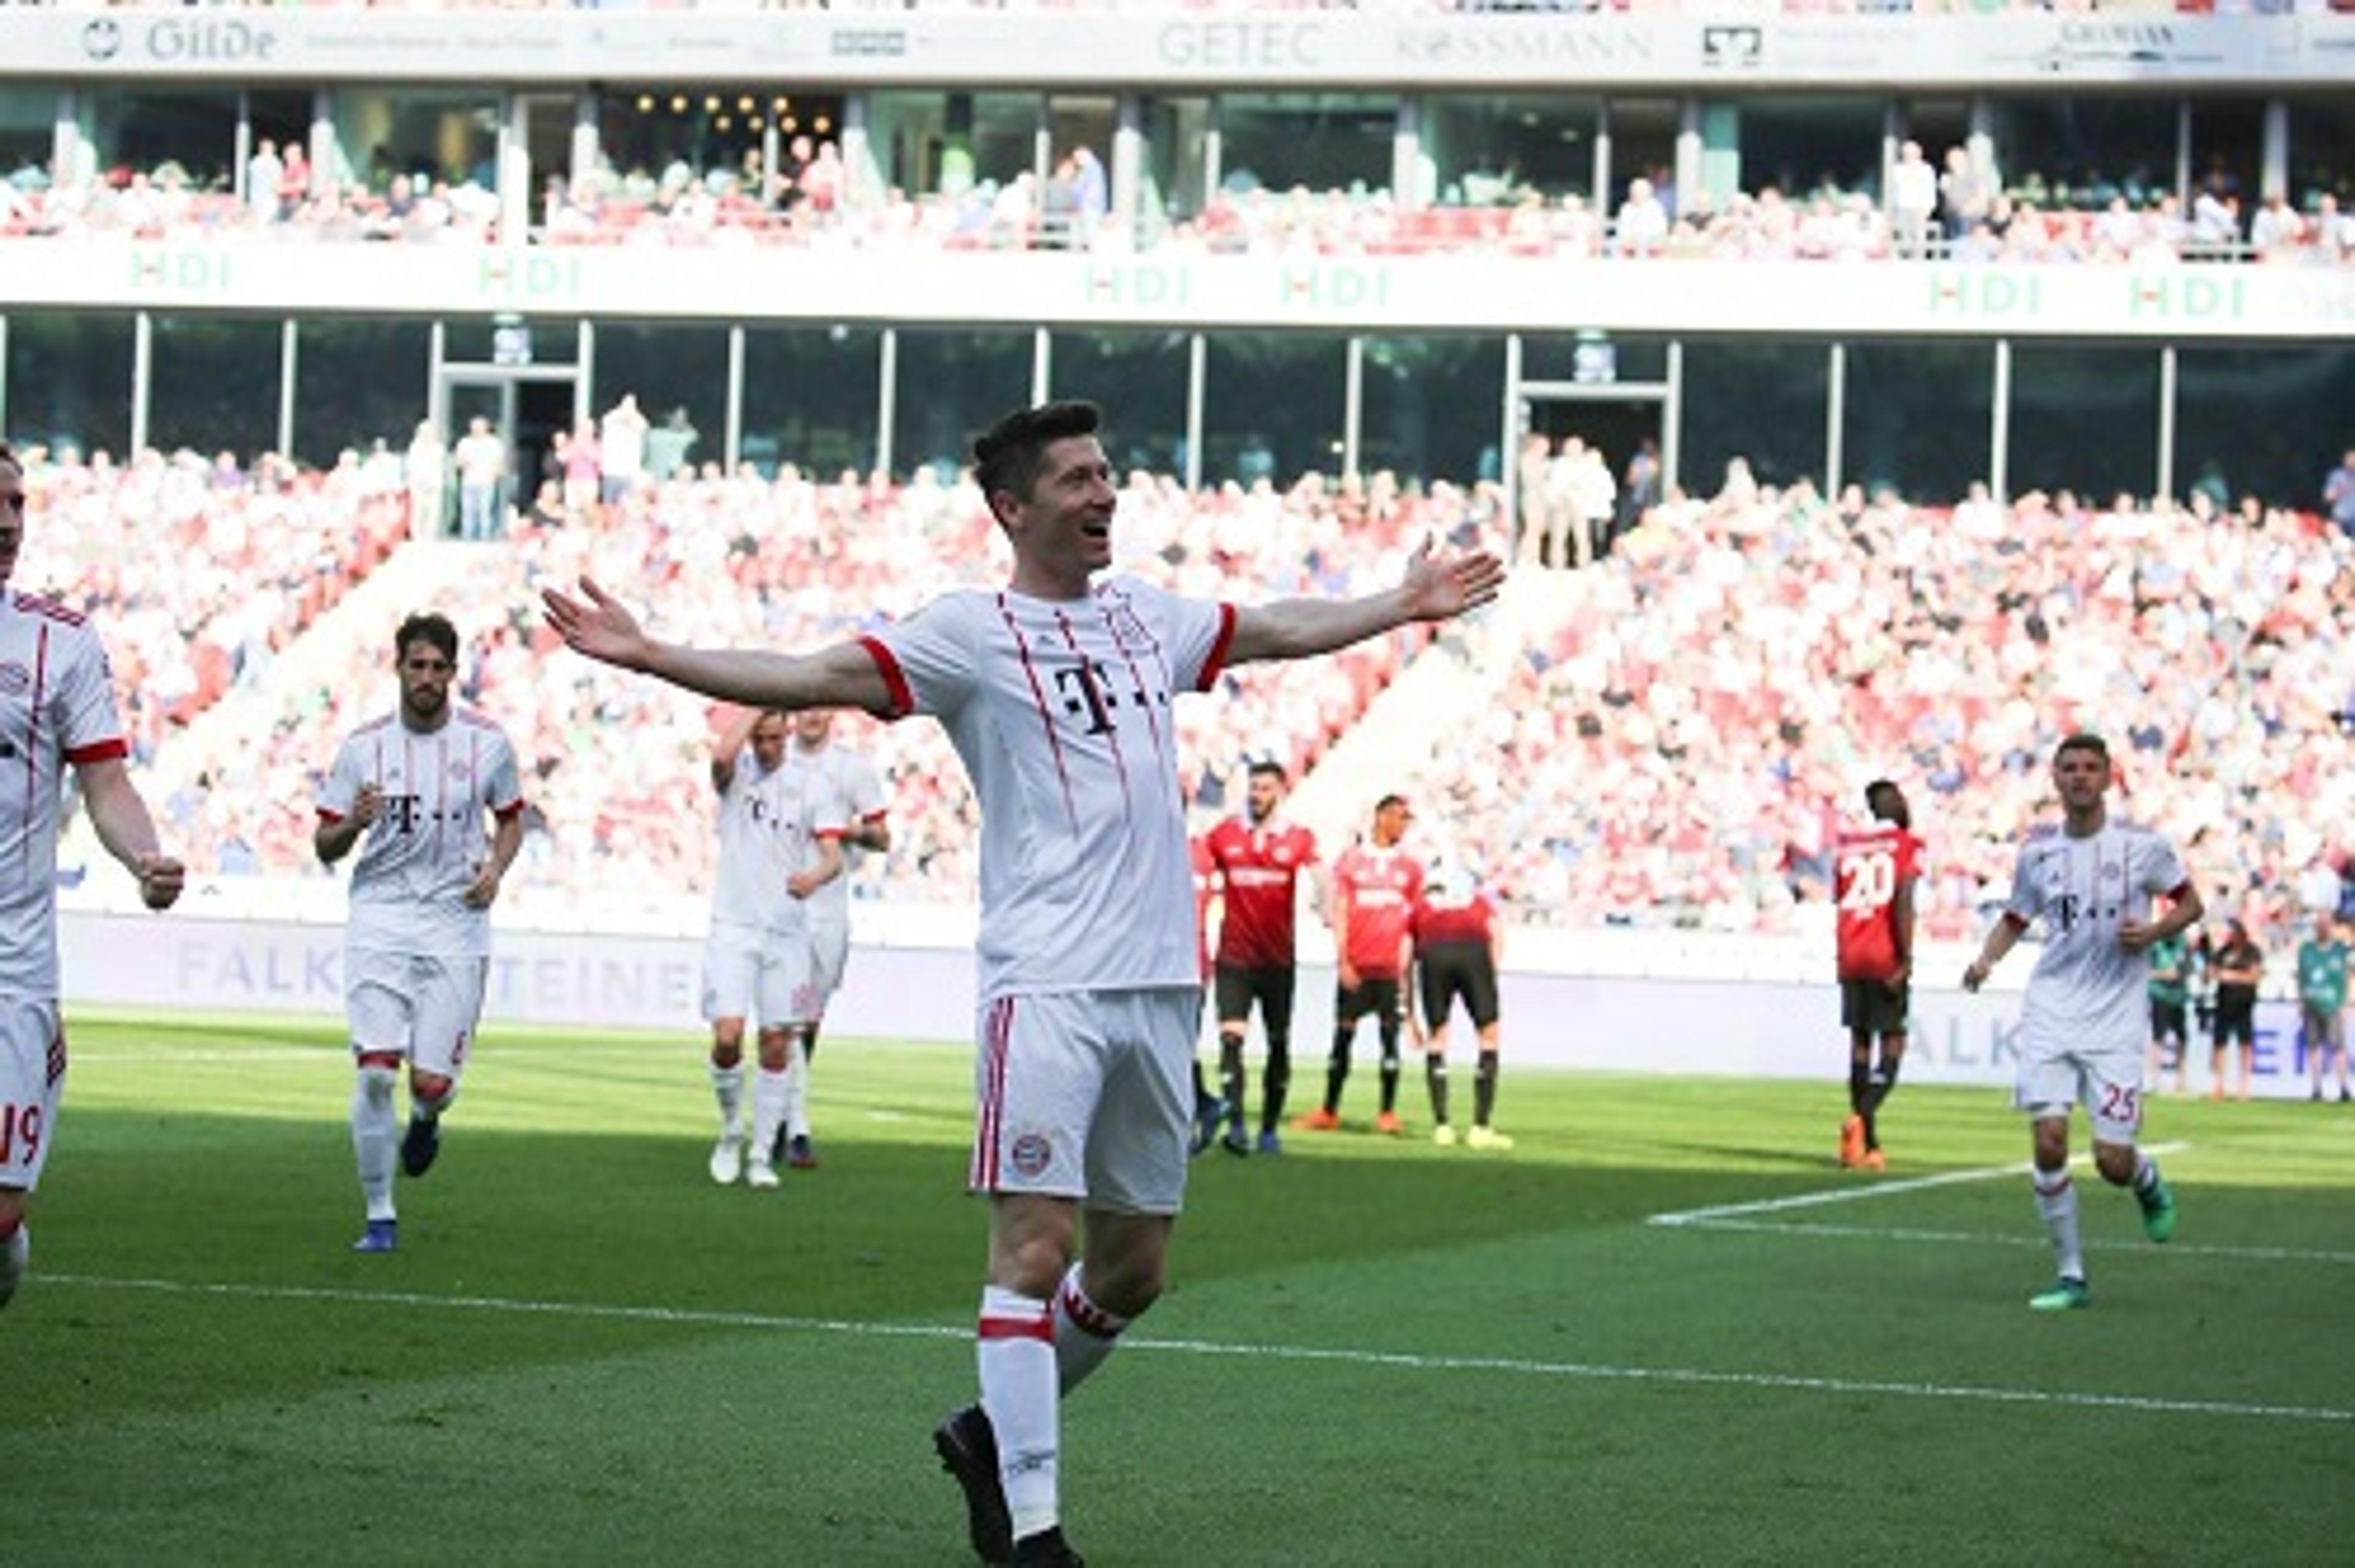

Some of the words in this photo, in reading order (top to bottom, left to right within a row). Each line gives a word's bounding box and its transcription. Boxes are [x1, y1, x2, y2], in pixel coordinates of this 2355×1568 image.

[1158, 23, 1323, 67] GETEC
[131, 251, 231, 288] HDI
[479, 254, 581, 295] HDI
[1084, 262, 1189, 304] HDI
[1279, 267, 1390, 307] HDI
[1929, 272, 2042, 313] HDI
[2127, 275, 2245, 318] HDI
[1840, 854, 1894, 908] 20
[2100, 1083, 2135, 1122] 25
